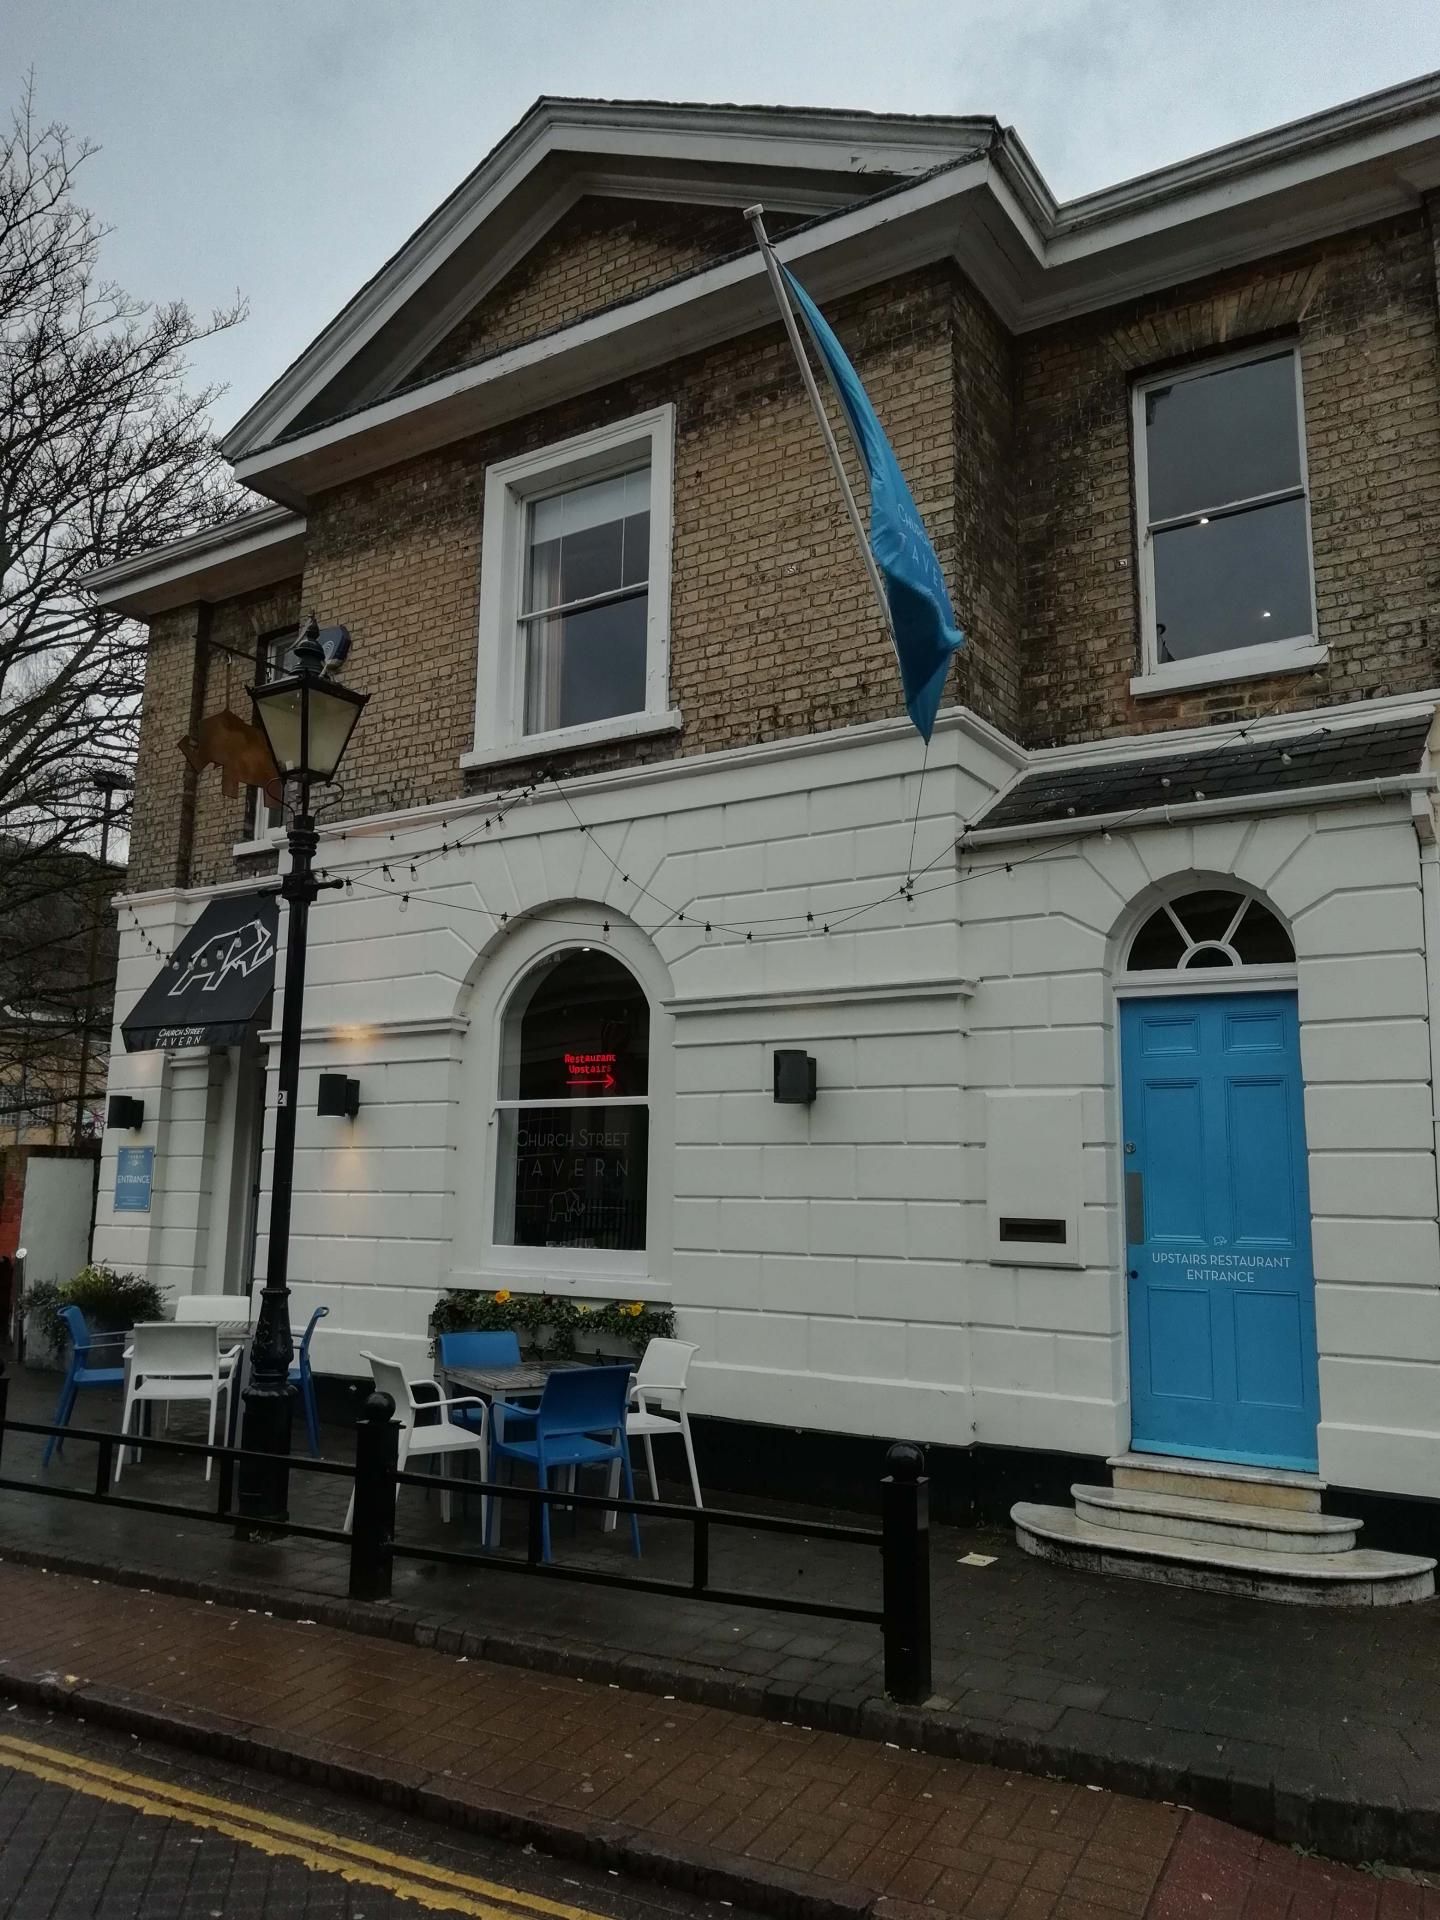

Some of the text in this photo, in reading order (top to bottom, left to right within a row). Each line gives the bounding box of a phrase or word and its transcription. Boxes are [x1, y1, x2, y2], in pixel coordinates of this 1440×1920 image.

[158, 1026, 206, 1037] CHURCH STREET
[155, 1035, 202, 1048] TAVERN
[564, 1053, 617, 1064] Restaurant
[277, 1092, 284, 1105] 2
[516, 1128, 631, 1147] CHURCH STREET
[516, 1158, 629, 1177] TAVERN
[117, 1174, 151, 1184] ENTRANCE
[1152, 1252, 1291, 1269] UPSTAIRS RESTAURANT
[1187, 1269, 1256, 1283] ENTRANCE
